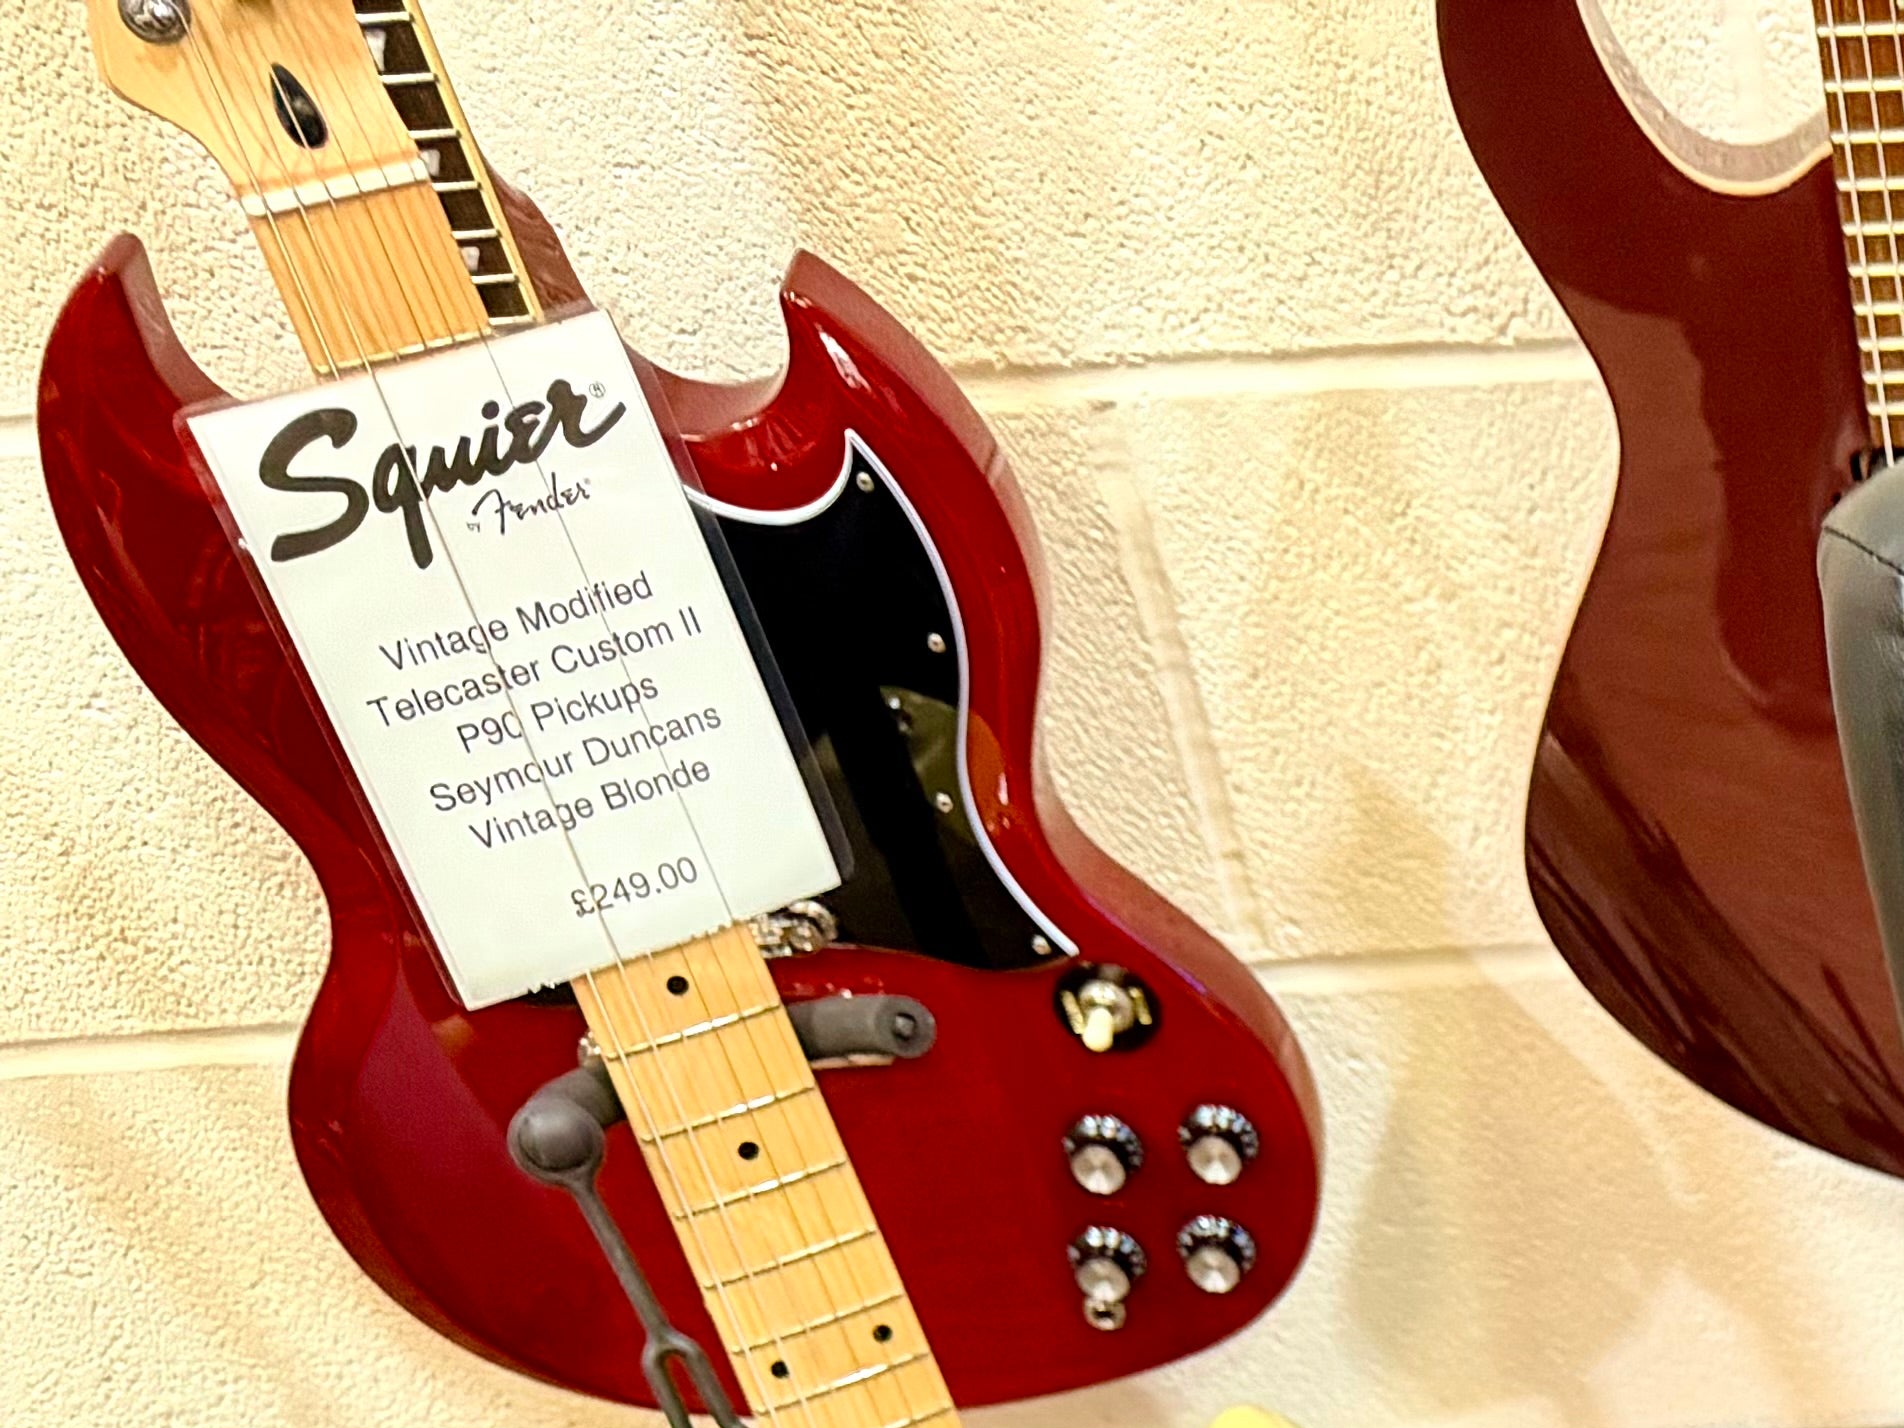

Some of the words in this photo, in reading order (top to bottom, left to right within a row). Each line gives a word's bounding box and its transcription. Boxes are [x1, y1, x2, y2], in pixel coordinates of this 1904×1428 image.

[259, 379, 626, 569] Squier
[471, 471, 590, 535] Fender
[379, 619, 509, 671] Vintage
[515, 570, 654, 634] Modified
[366, 660, 541, 728] Telecaster
[551, 621, 675, 673] Custom
[530, 677, 658, 732] Pickups
[429, 751, 574, 812] Seymour
[582, 707, 722, 767] Duncans
[468, 797, 595, 849] Vintage
[600, 760, 711, 811] Blonde
[570, 857, 698, 918] £249.00
